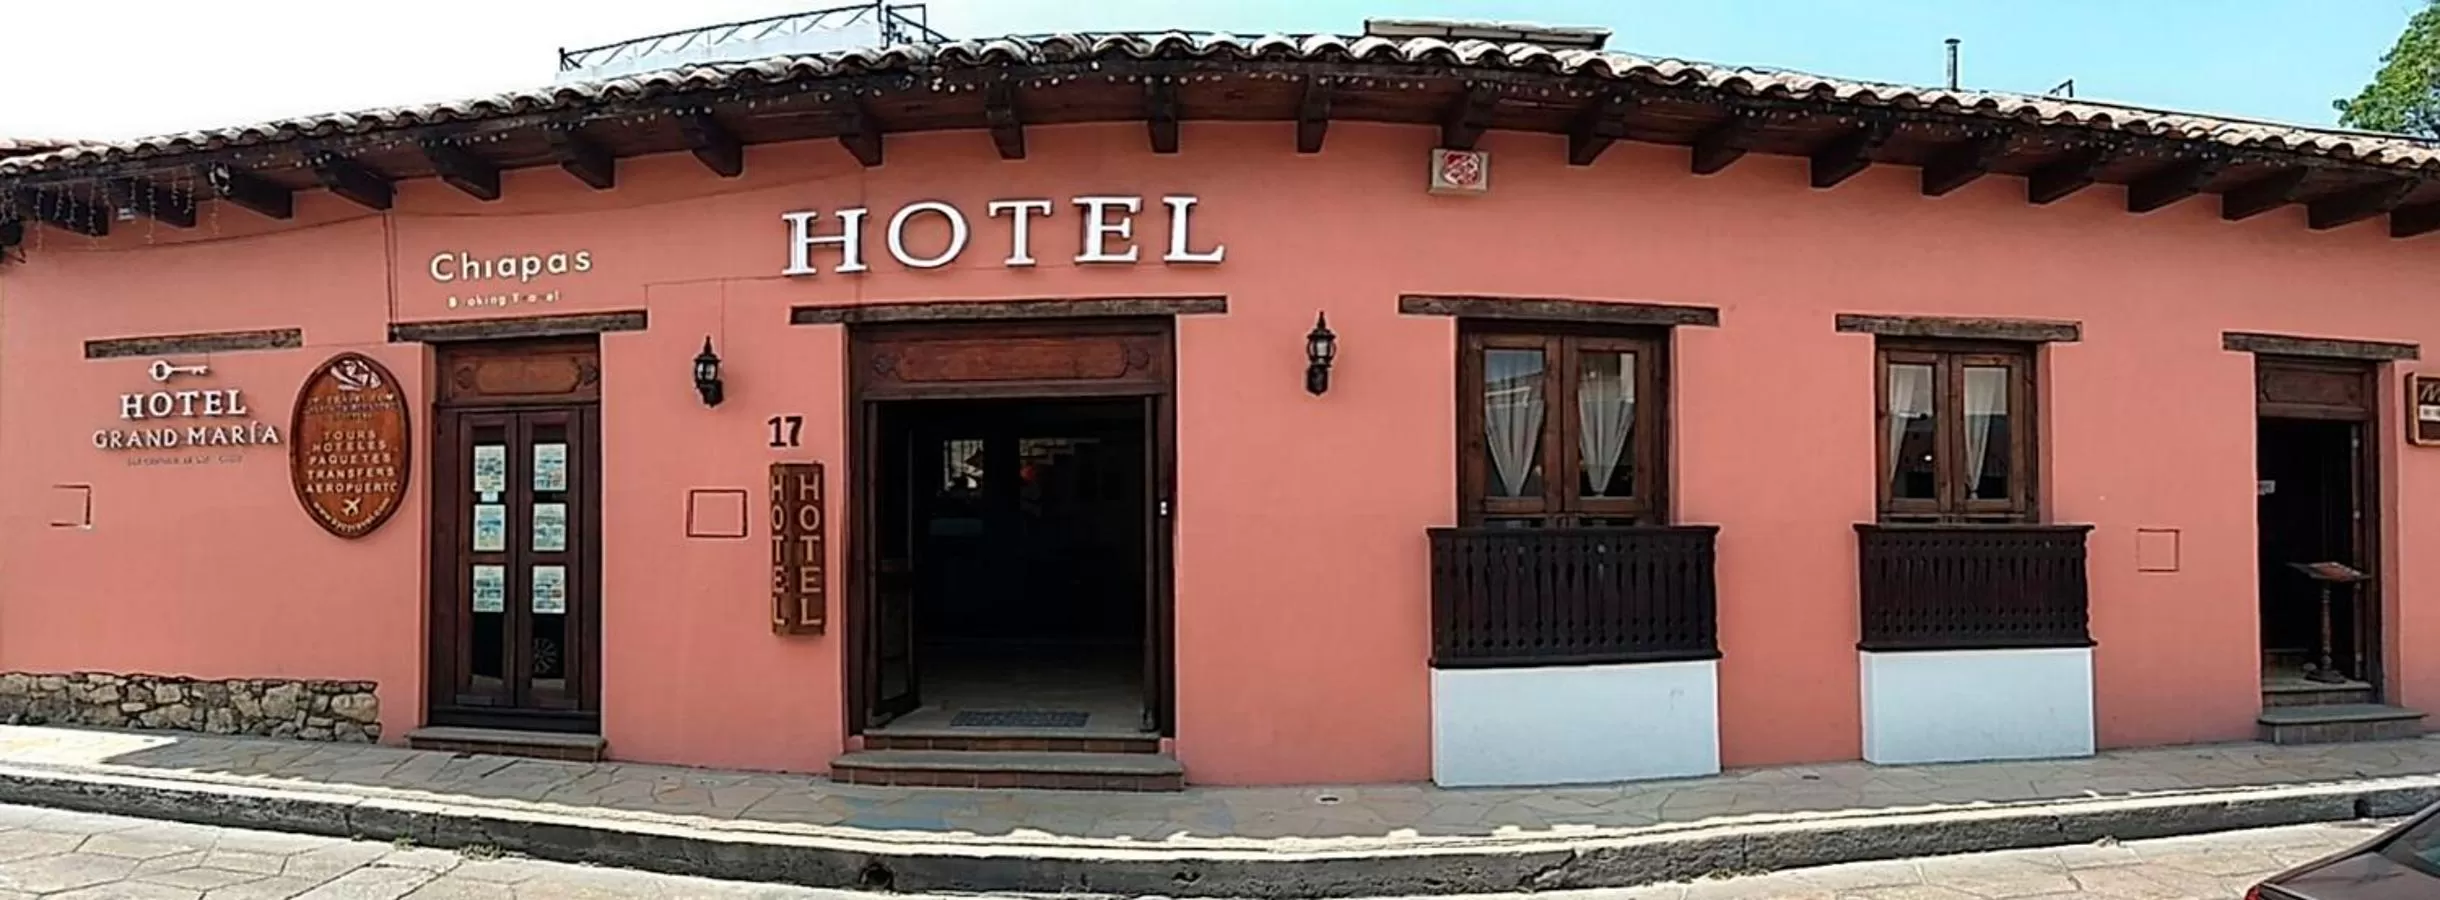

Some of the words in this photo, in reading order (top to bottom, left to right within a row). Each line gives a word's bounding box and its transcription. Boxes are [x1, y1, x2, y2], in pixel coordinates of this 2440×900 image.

[782, 195, 1226, 277] HOTEL
[430, 250, 593, 283] Chiapas
[448, 294, 507, 309] Boking
[120, 389, 248, 419] HOTEL
[92, 428, 179, 449] GRAND
[187, 420, 280, 446] MARÍA
[324, 430, 377, 441] TOURS
[767, 415, 803, 447] 17
[308, 452, 392, 465] PAQUETES
[312, 440, 388, 453] HOTELES
[306, 466, 396, 479] TRANSFERS
[770, 474, 787, 626] HOTEL
[799, 473, 822, 626] HOTEL
